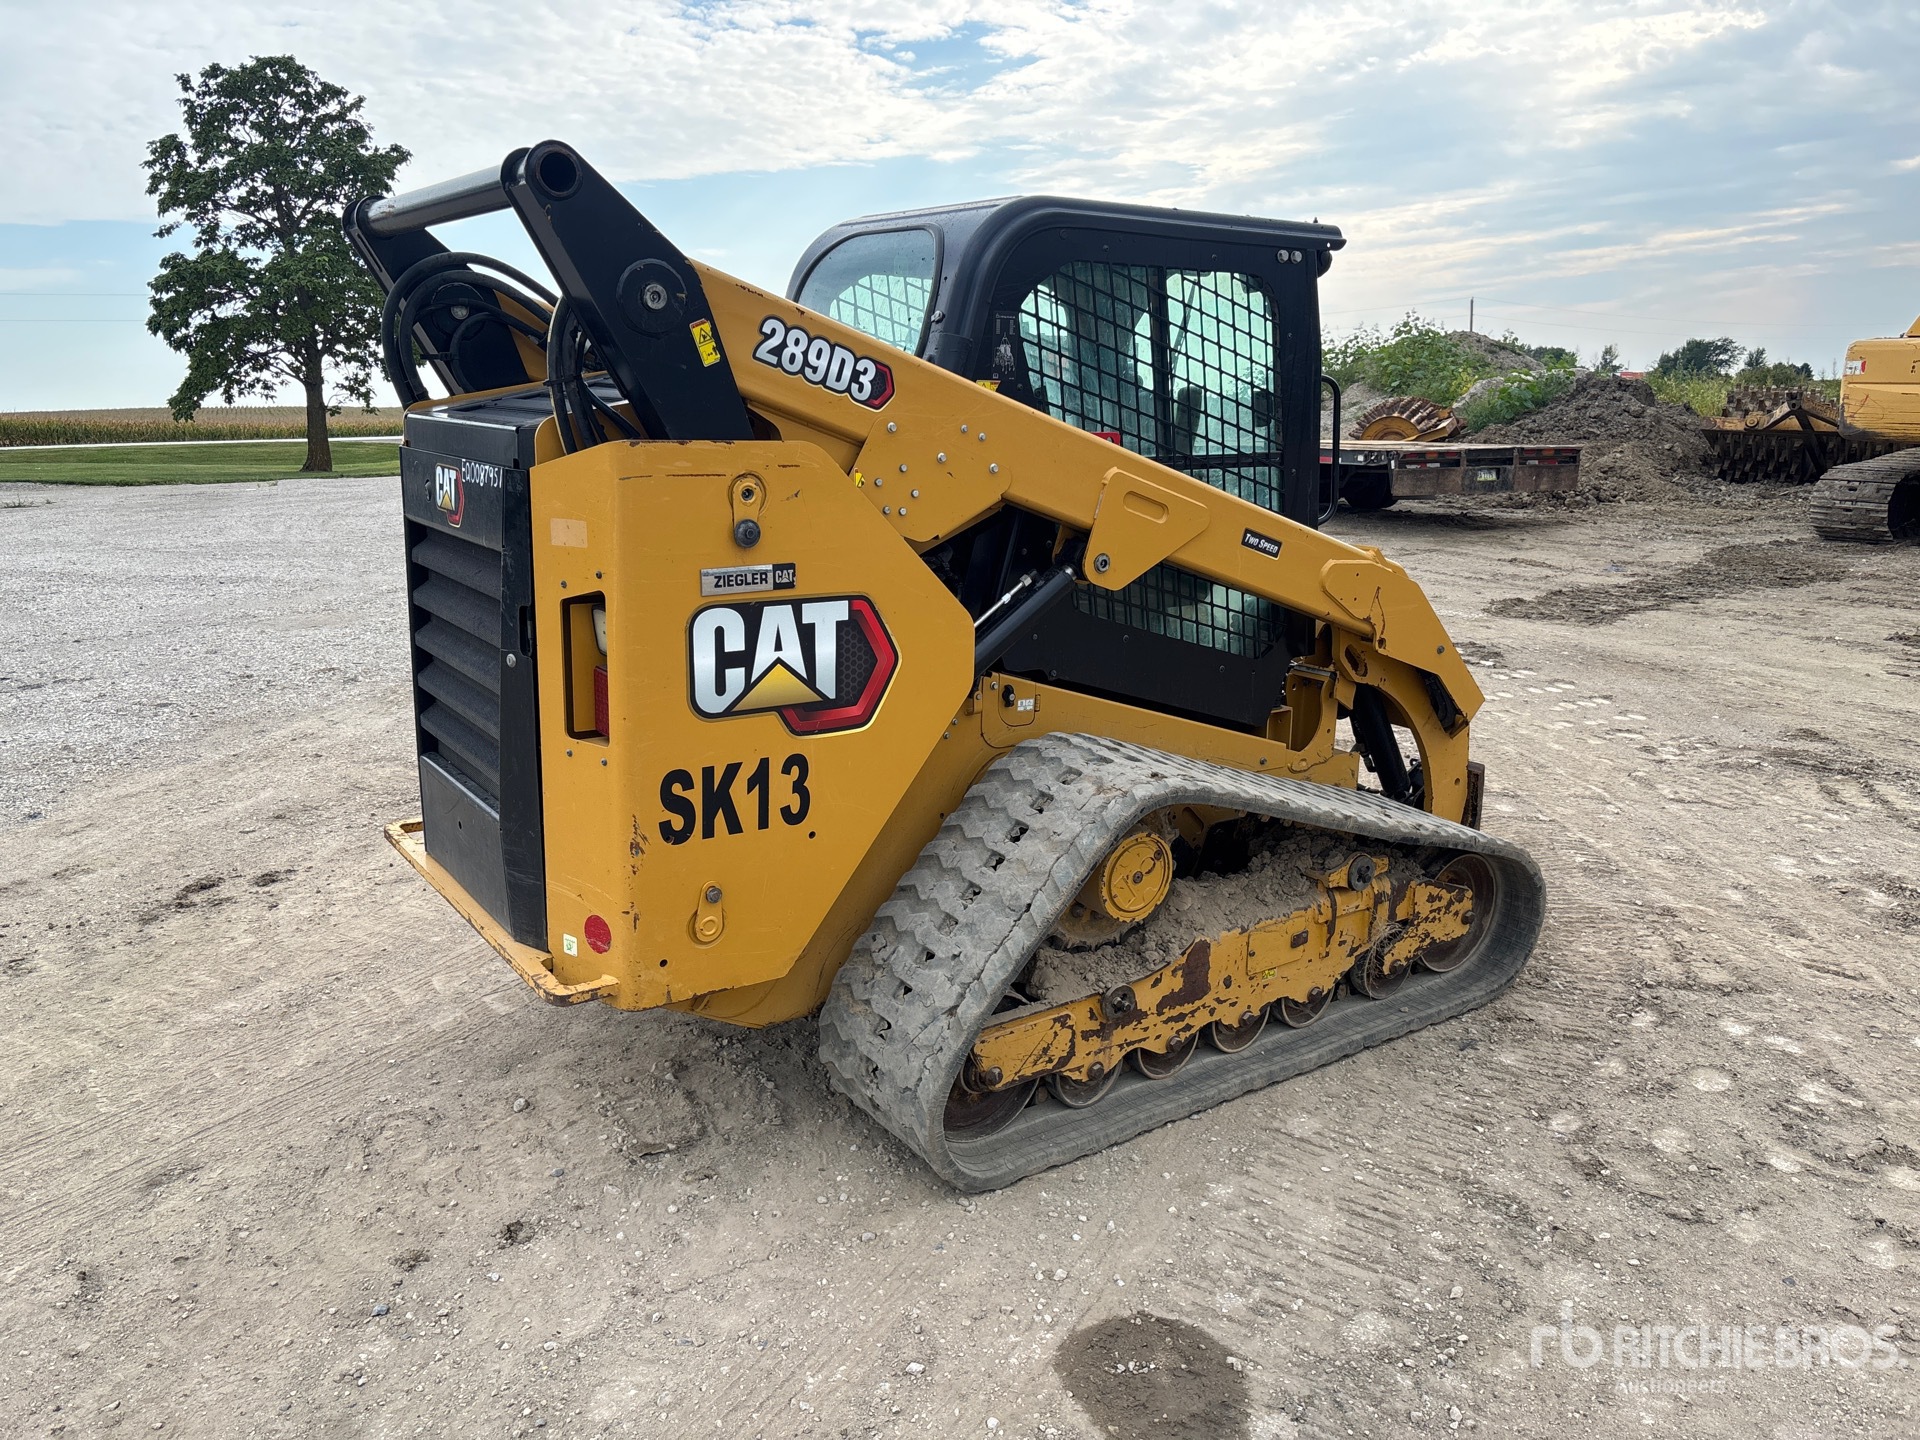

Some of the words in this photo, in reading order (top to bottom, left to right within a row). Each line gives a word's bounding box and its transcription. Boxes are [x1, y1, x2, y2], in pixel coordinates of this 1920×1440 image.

[755, 318, 876, 401] 289D3
[435, 466, 457, 511] CAT
[714, 572, 768, 589] ZIEGLER
[775, 569, 794, 584] CAT
[692, 600, 849, 713] CAT
[658, 752, 811, 846] SK13
